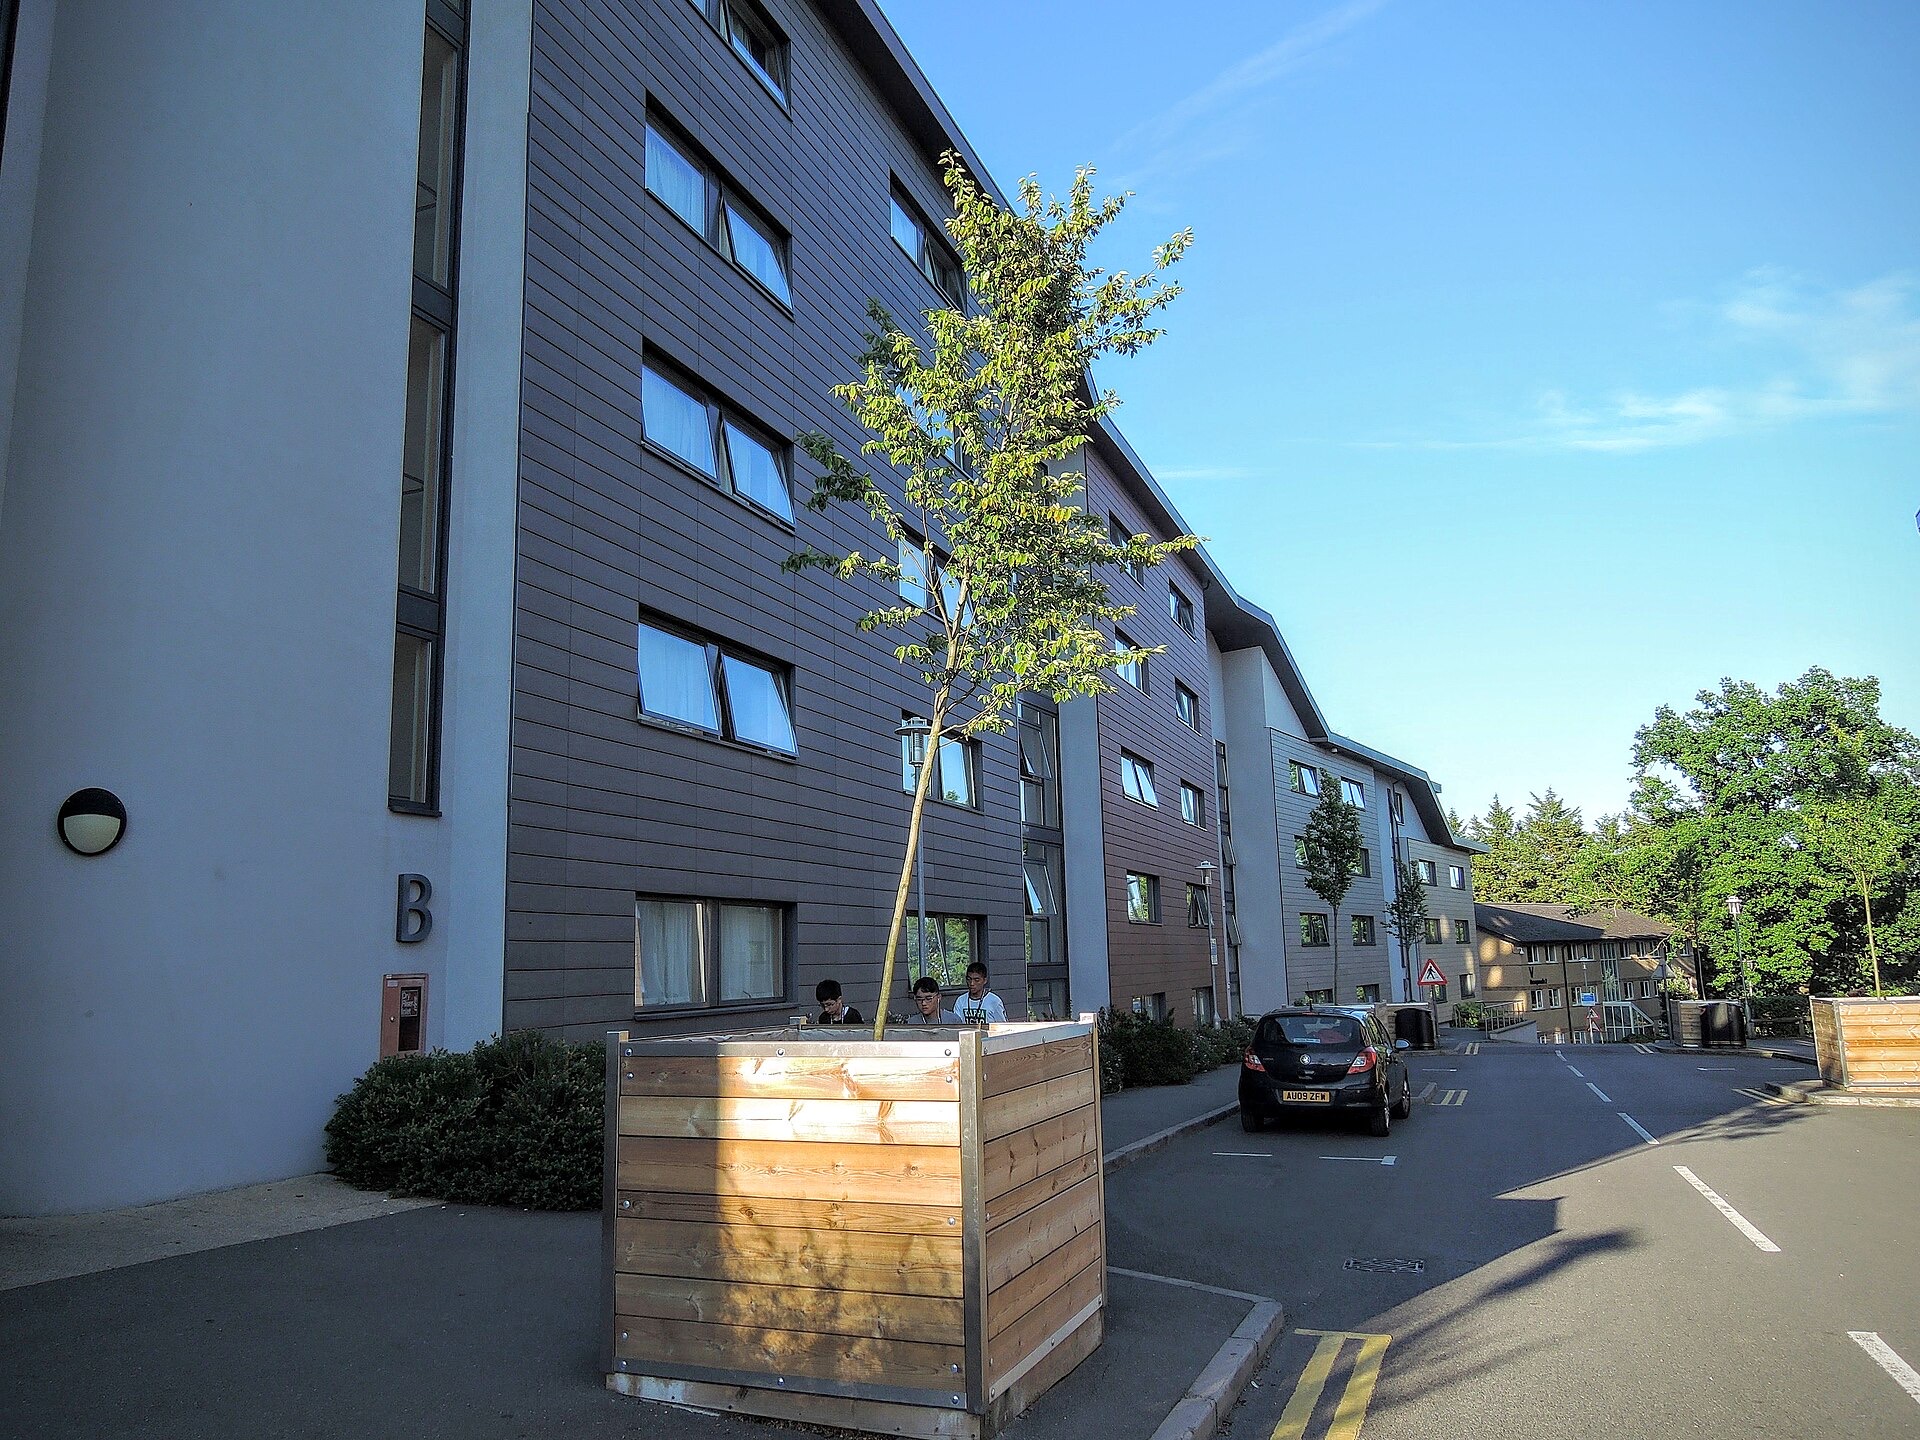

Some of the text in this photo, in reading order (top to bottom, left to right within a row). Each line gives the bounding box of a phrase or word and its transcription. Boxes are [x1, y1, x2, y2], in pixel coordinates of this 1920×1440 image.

[396, 874, 432, 943] B
[1286, 1091, 1326, 1101] AU09 ZFW
